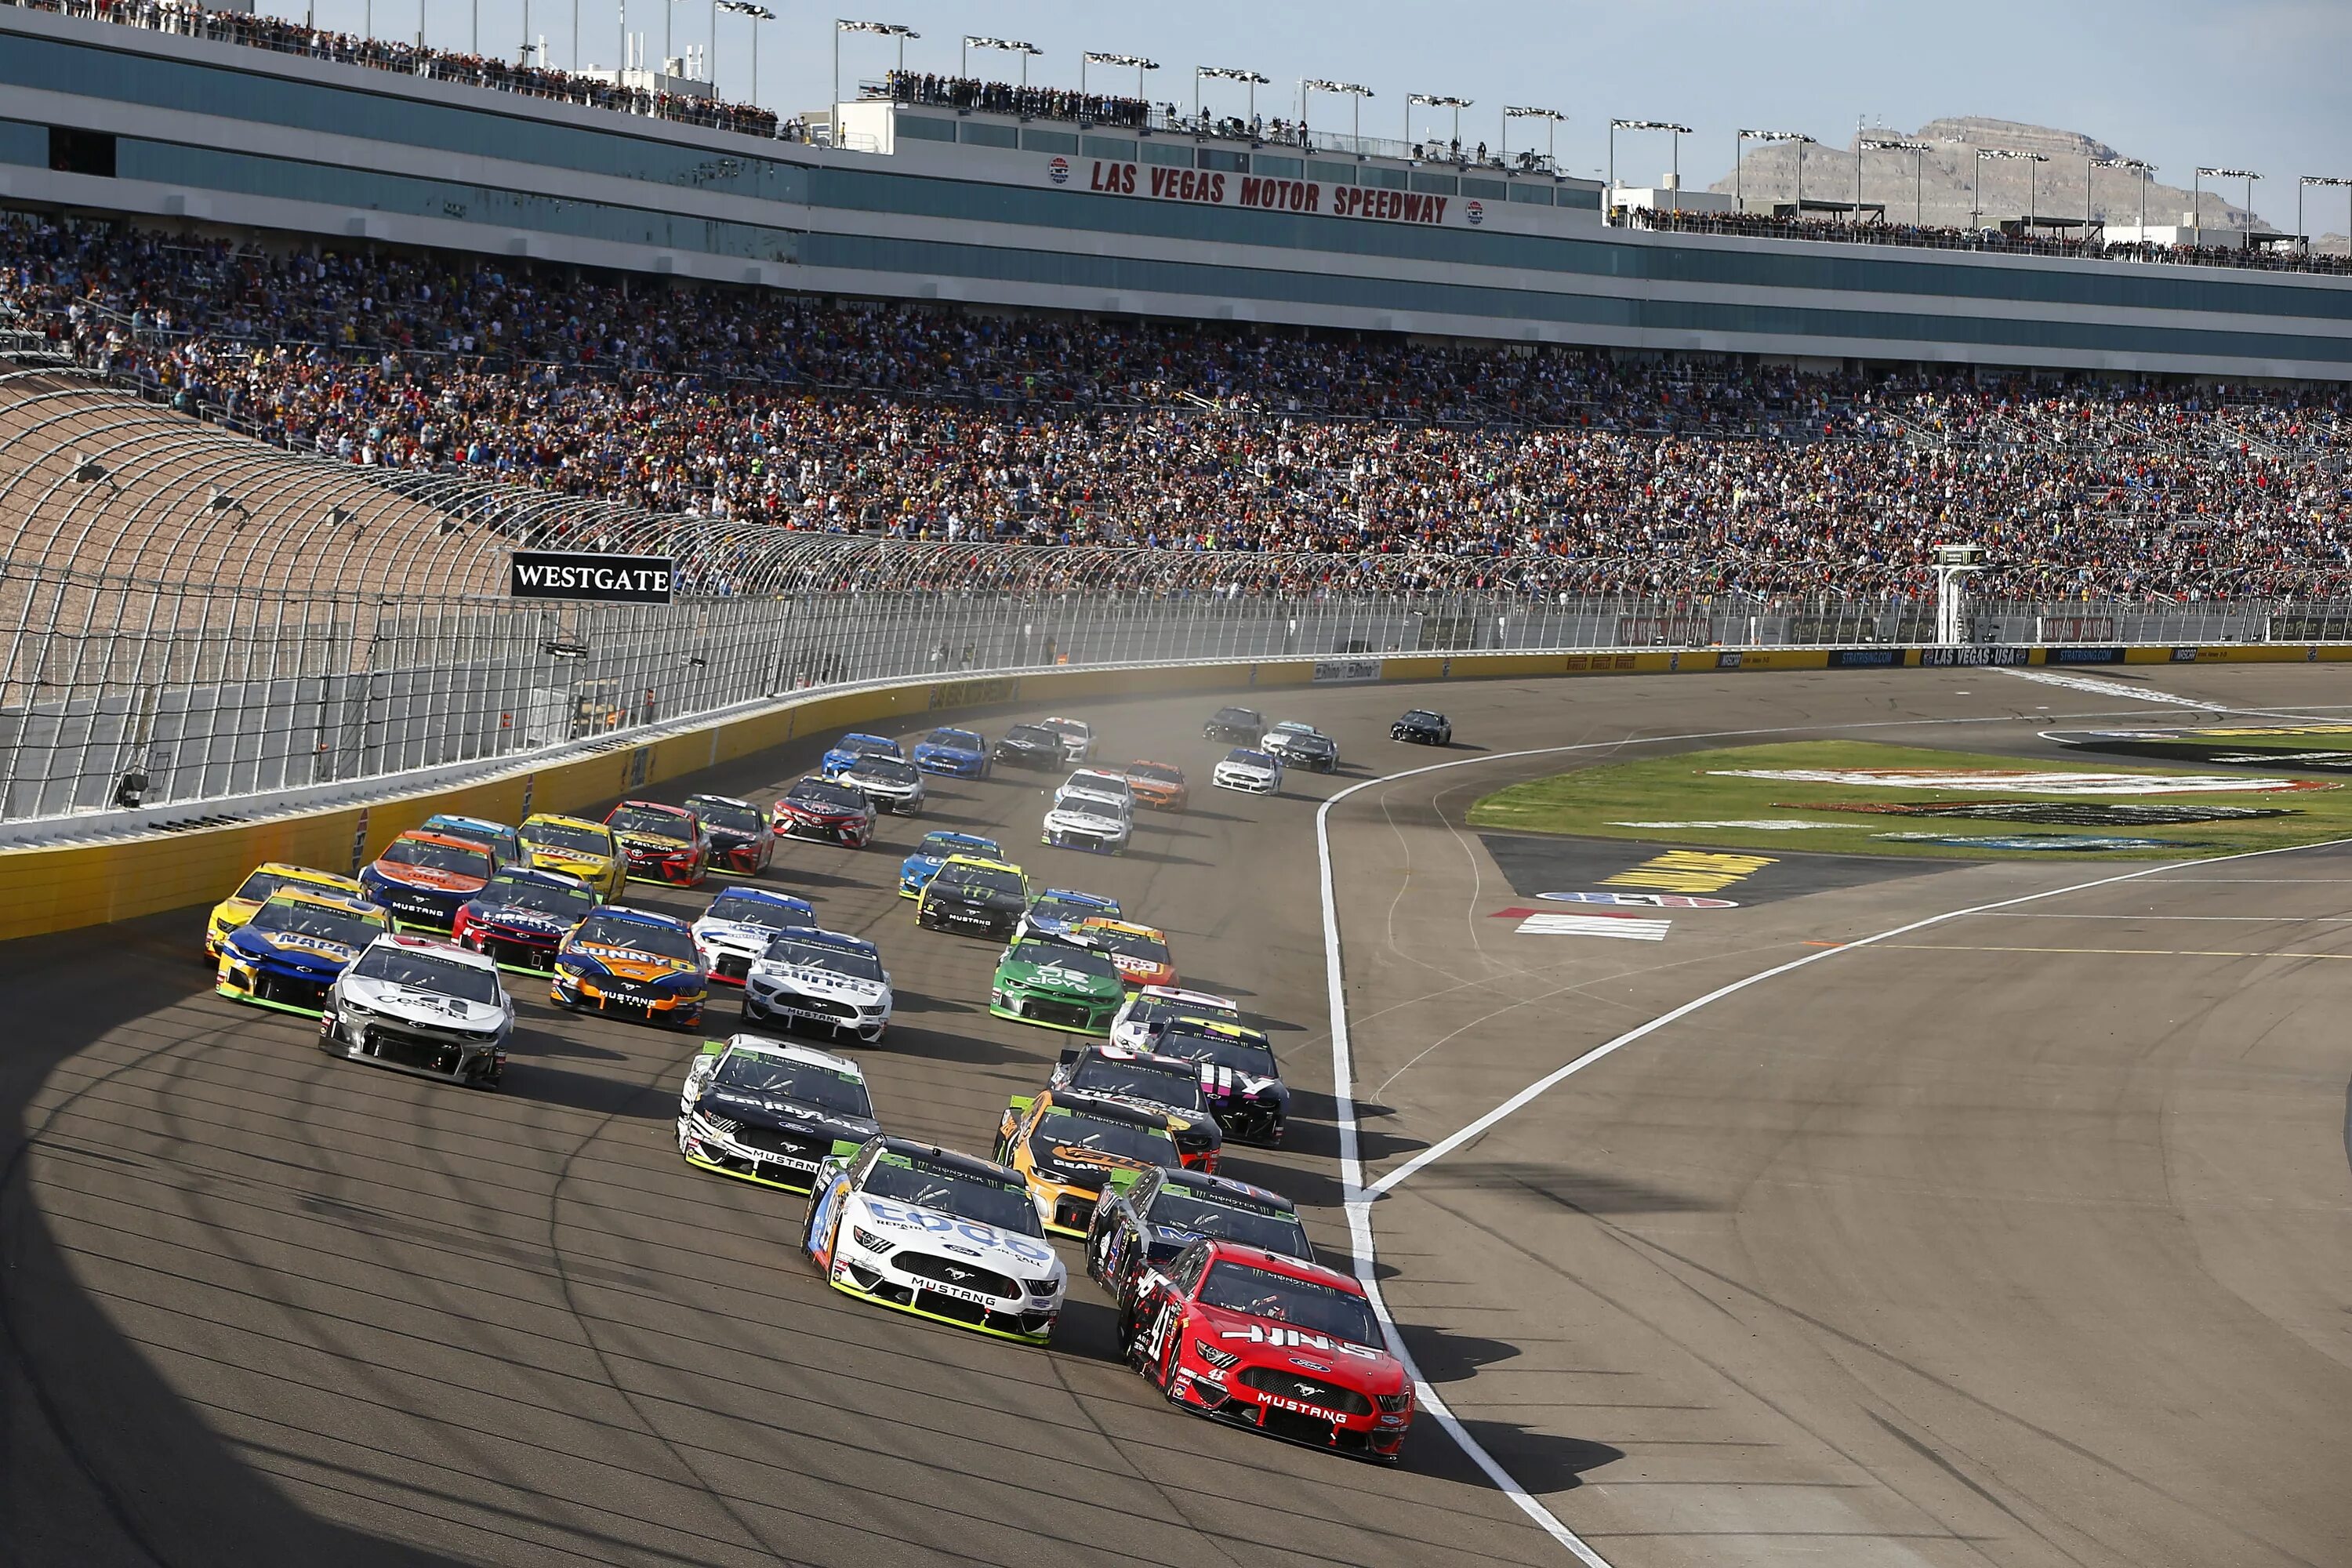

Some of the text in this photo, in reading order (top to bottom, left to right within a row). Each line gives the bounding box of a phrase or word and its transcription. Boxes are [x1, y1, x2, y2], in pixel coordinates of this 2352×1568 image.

[1091, 161, 1448, 225] LAS VEGAS MOTOR SPEEDWAY
[516, 564, 669, 592] WESTGATE
[1934, 648, 1954, 664] LAS
[392, 902, 445, 917] MUSTANG
[949, 913, 992, 926] MUSTANG
[278, 933, 350, 958] NAPA
[1025, 975, 1098, 996] clover
[599, 989, 656, 1007] MUSTANG
[376, 995, 470, 1020] Cessna
[787, 1007, 841, 1023] MUSTANG
[338, 1011, 348, 1024] 8
[753, 1149, 820, 1174] MUSTAN
[1053, 1158, 1112, 1173] GEARW
[932, 1165, 984, 1183] MONSTER
[1208, 1192, 1258, 1210] MONSTER
[876, 1219, 923, 1231] REPAIR
[949, 1244, 976, 1255] Ford
[1266, 1272, 1322, 1291] MONSTER
[911, 1276, 996, 1306] MUSTANG
[1296, 1358, 1323, 1370] Ford
[1257, 1392, 1348, 1425] MUSTANG
